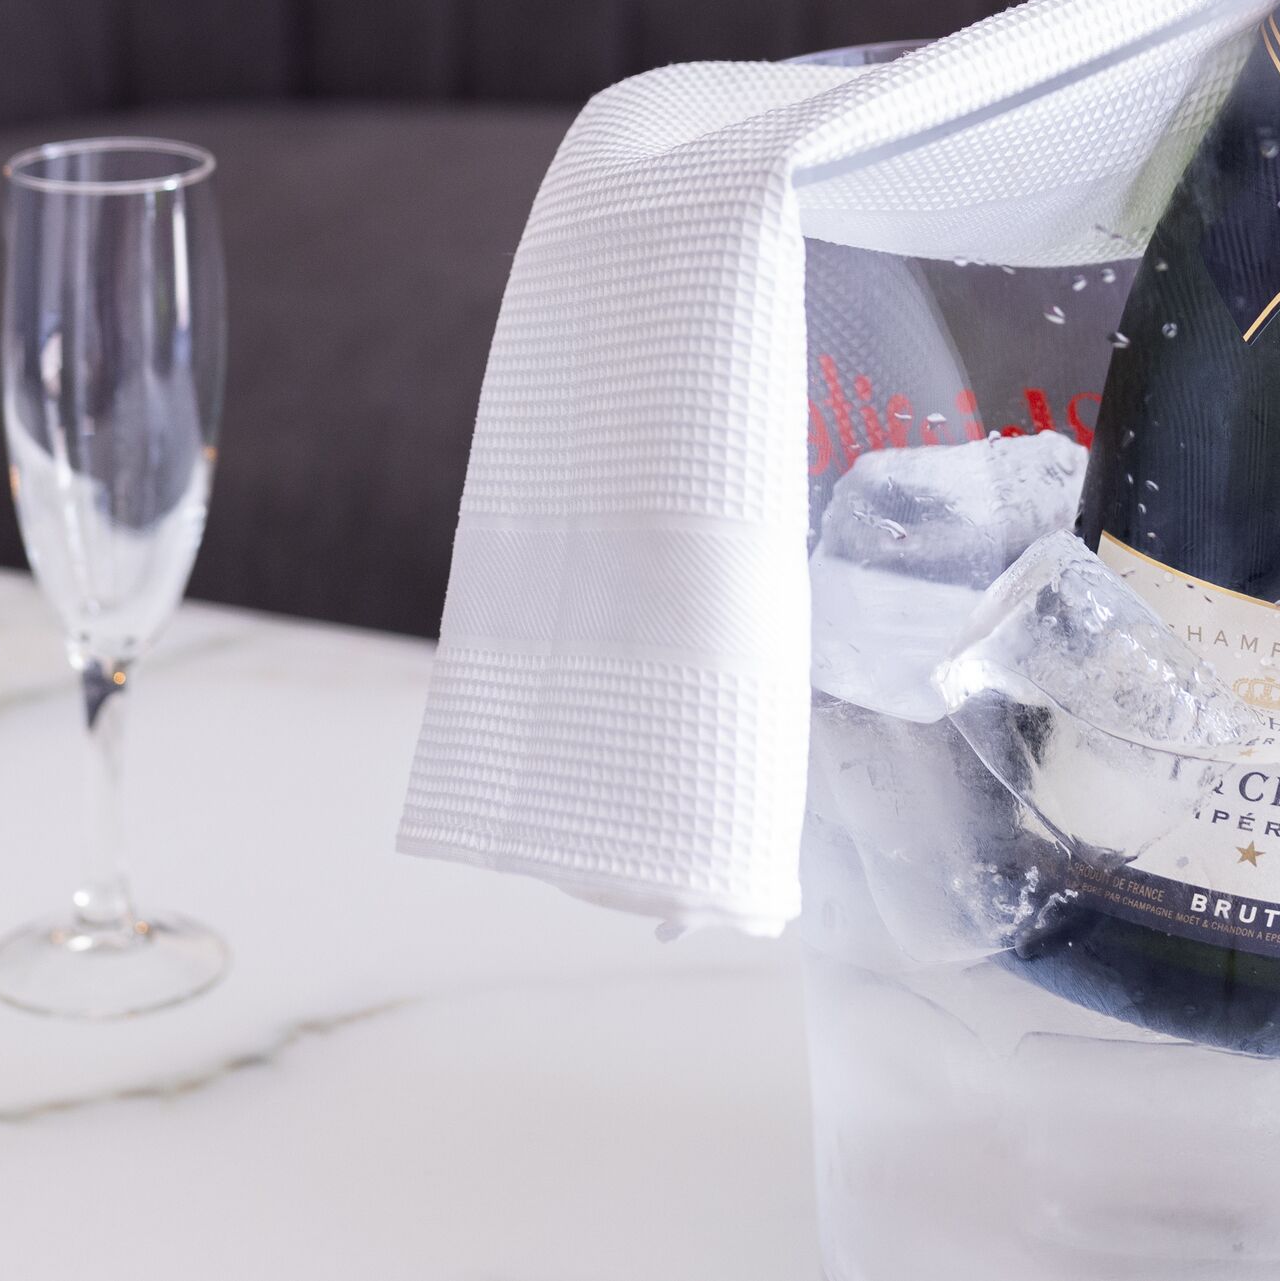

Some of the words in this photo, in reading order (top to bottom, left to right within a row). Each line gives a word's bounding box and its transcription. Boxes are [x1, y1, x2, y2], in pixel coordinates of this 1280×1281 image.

[1112, 877, 1125, 891] DE
[1126, 881, 1166, 904] FRANCE
[1122, 896, 1173, 920] CHAMPAGNE
[1201, 918, 1210, 929] &
[1211, 921, 1255, 939] CHANDON
[1190, 892, 1280, 928] BRUT
